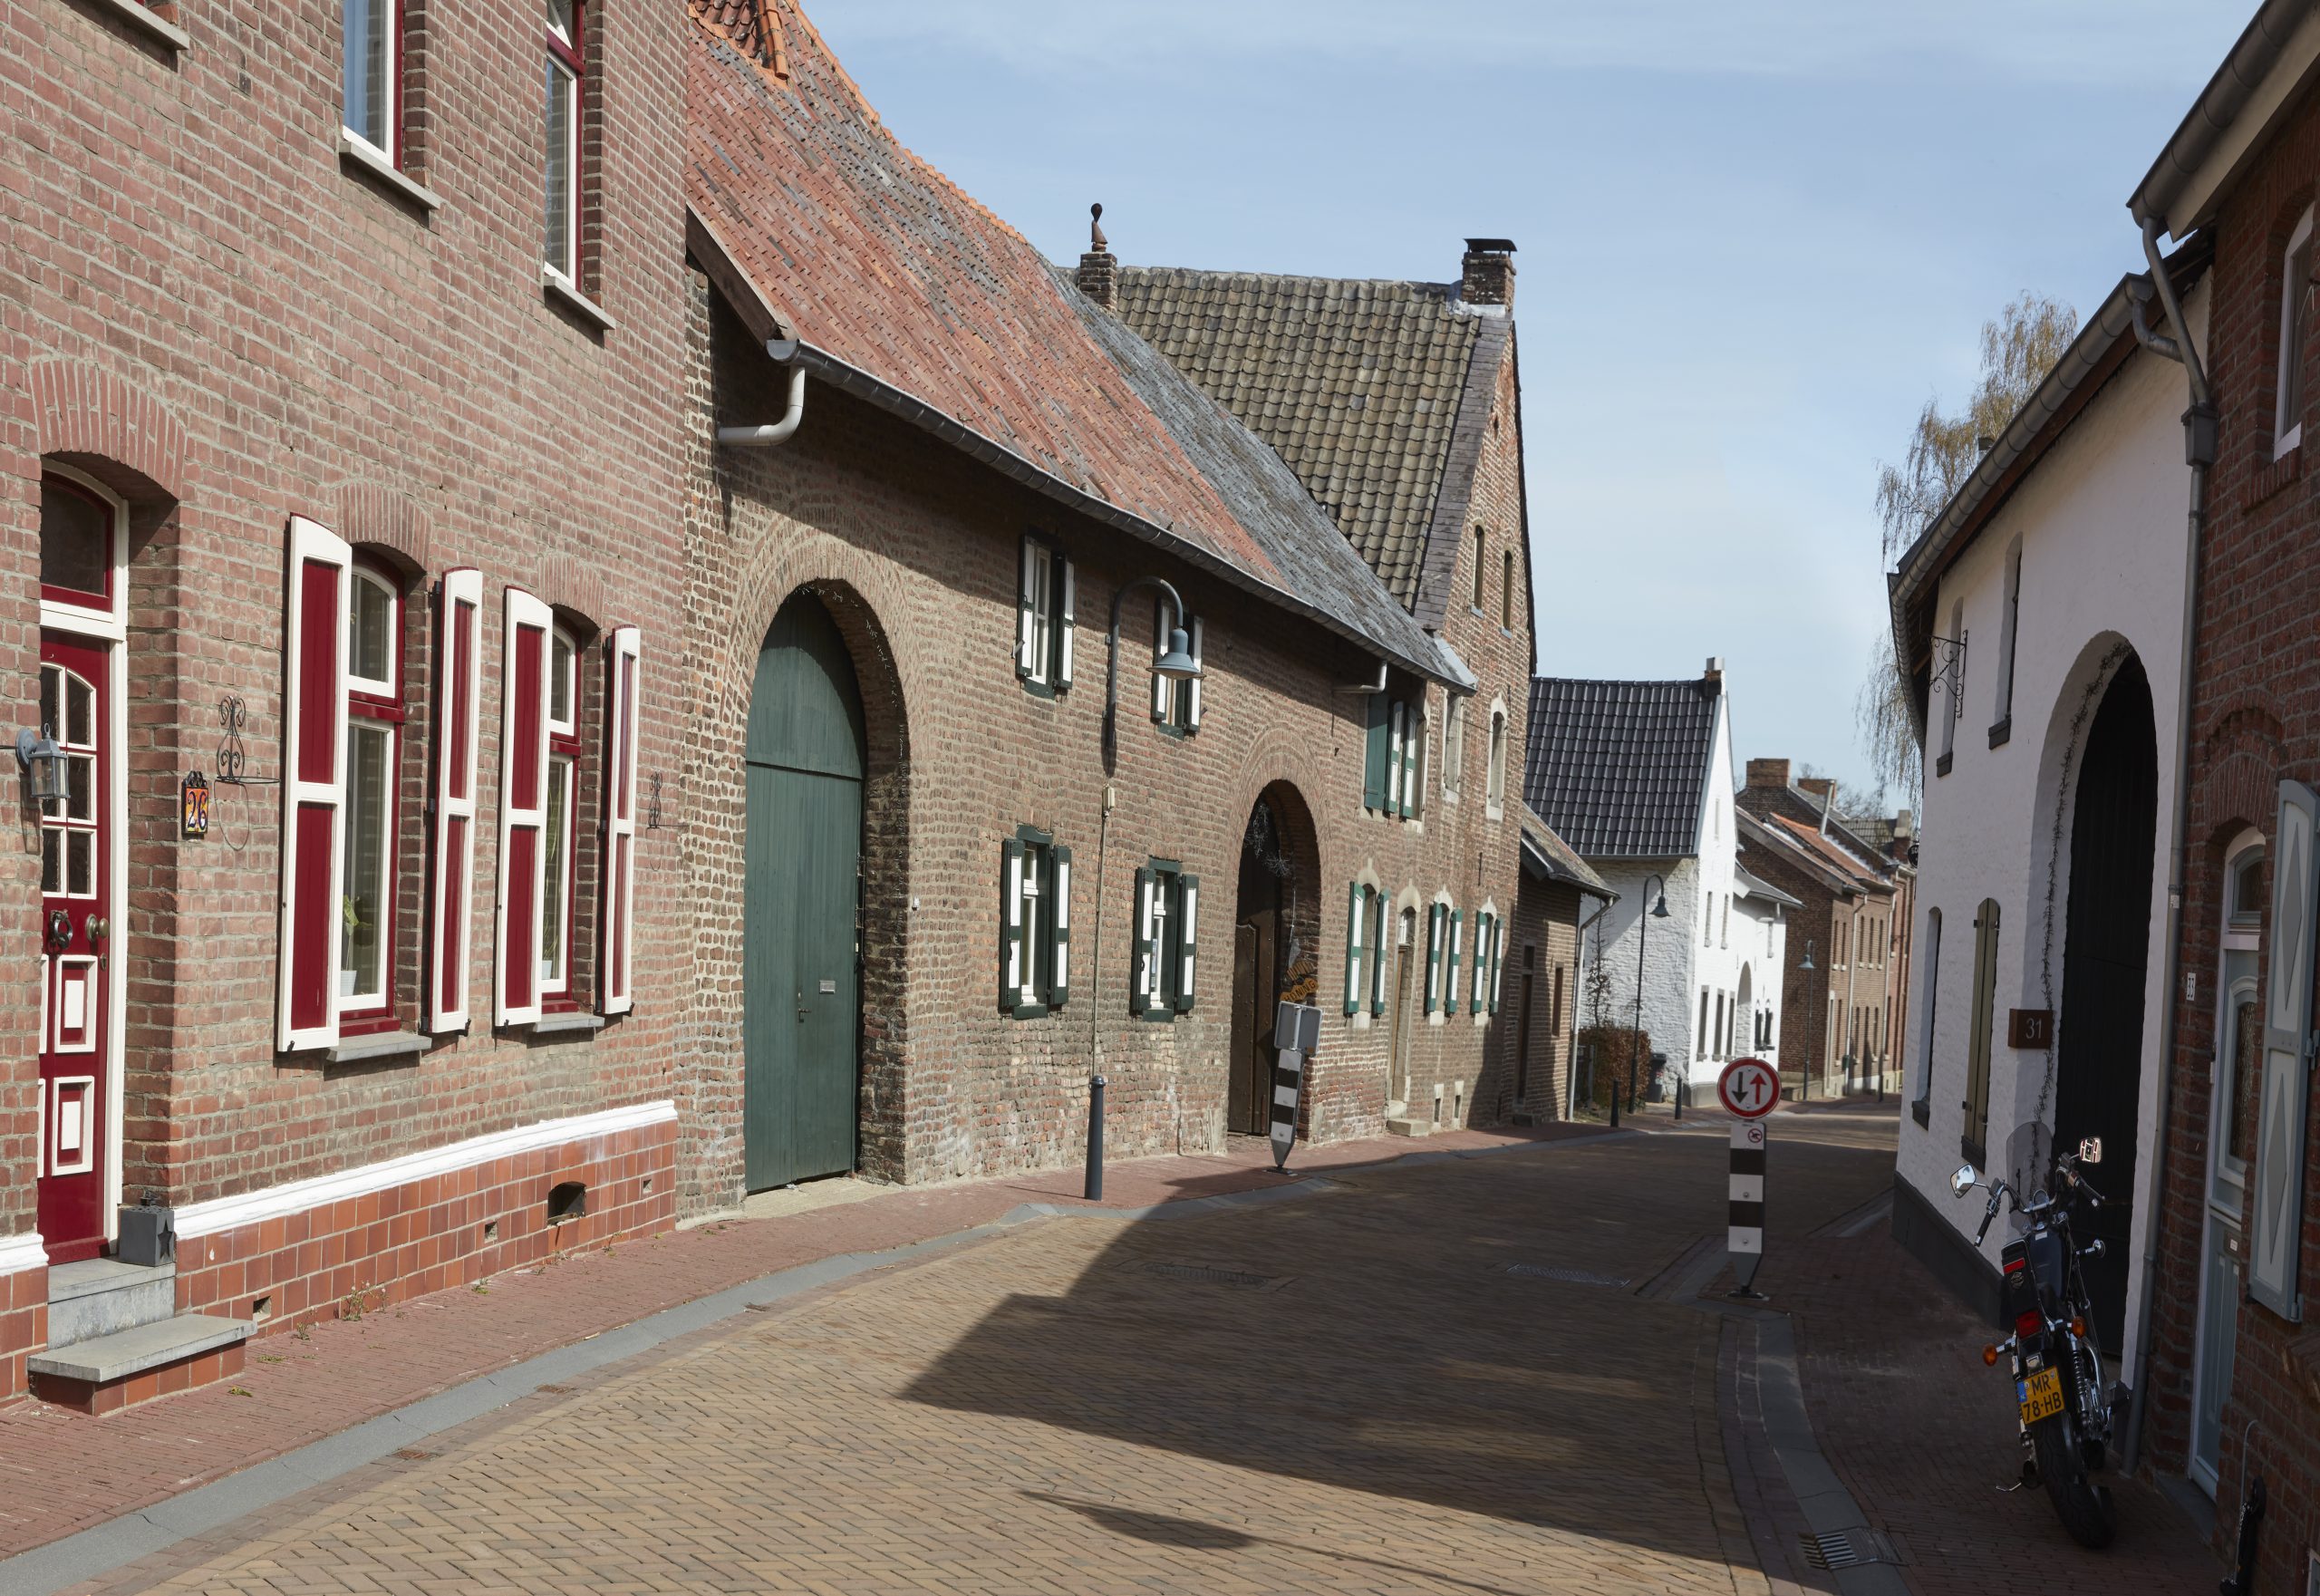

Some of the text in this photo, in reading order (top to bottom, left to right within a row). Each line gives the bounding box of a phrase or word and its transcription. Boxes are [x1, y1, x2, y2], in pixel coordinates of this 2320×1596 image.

[187, 790, 208, 830] 26
[2025, 1018, 2042, 1040] 31
[2031, 1374, 2051, 1396] MR
